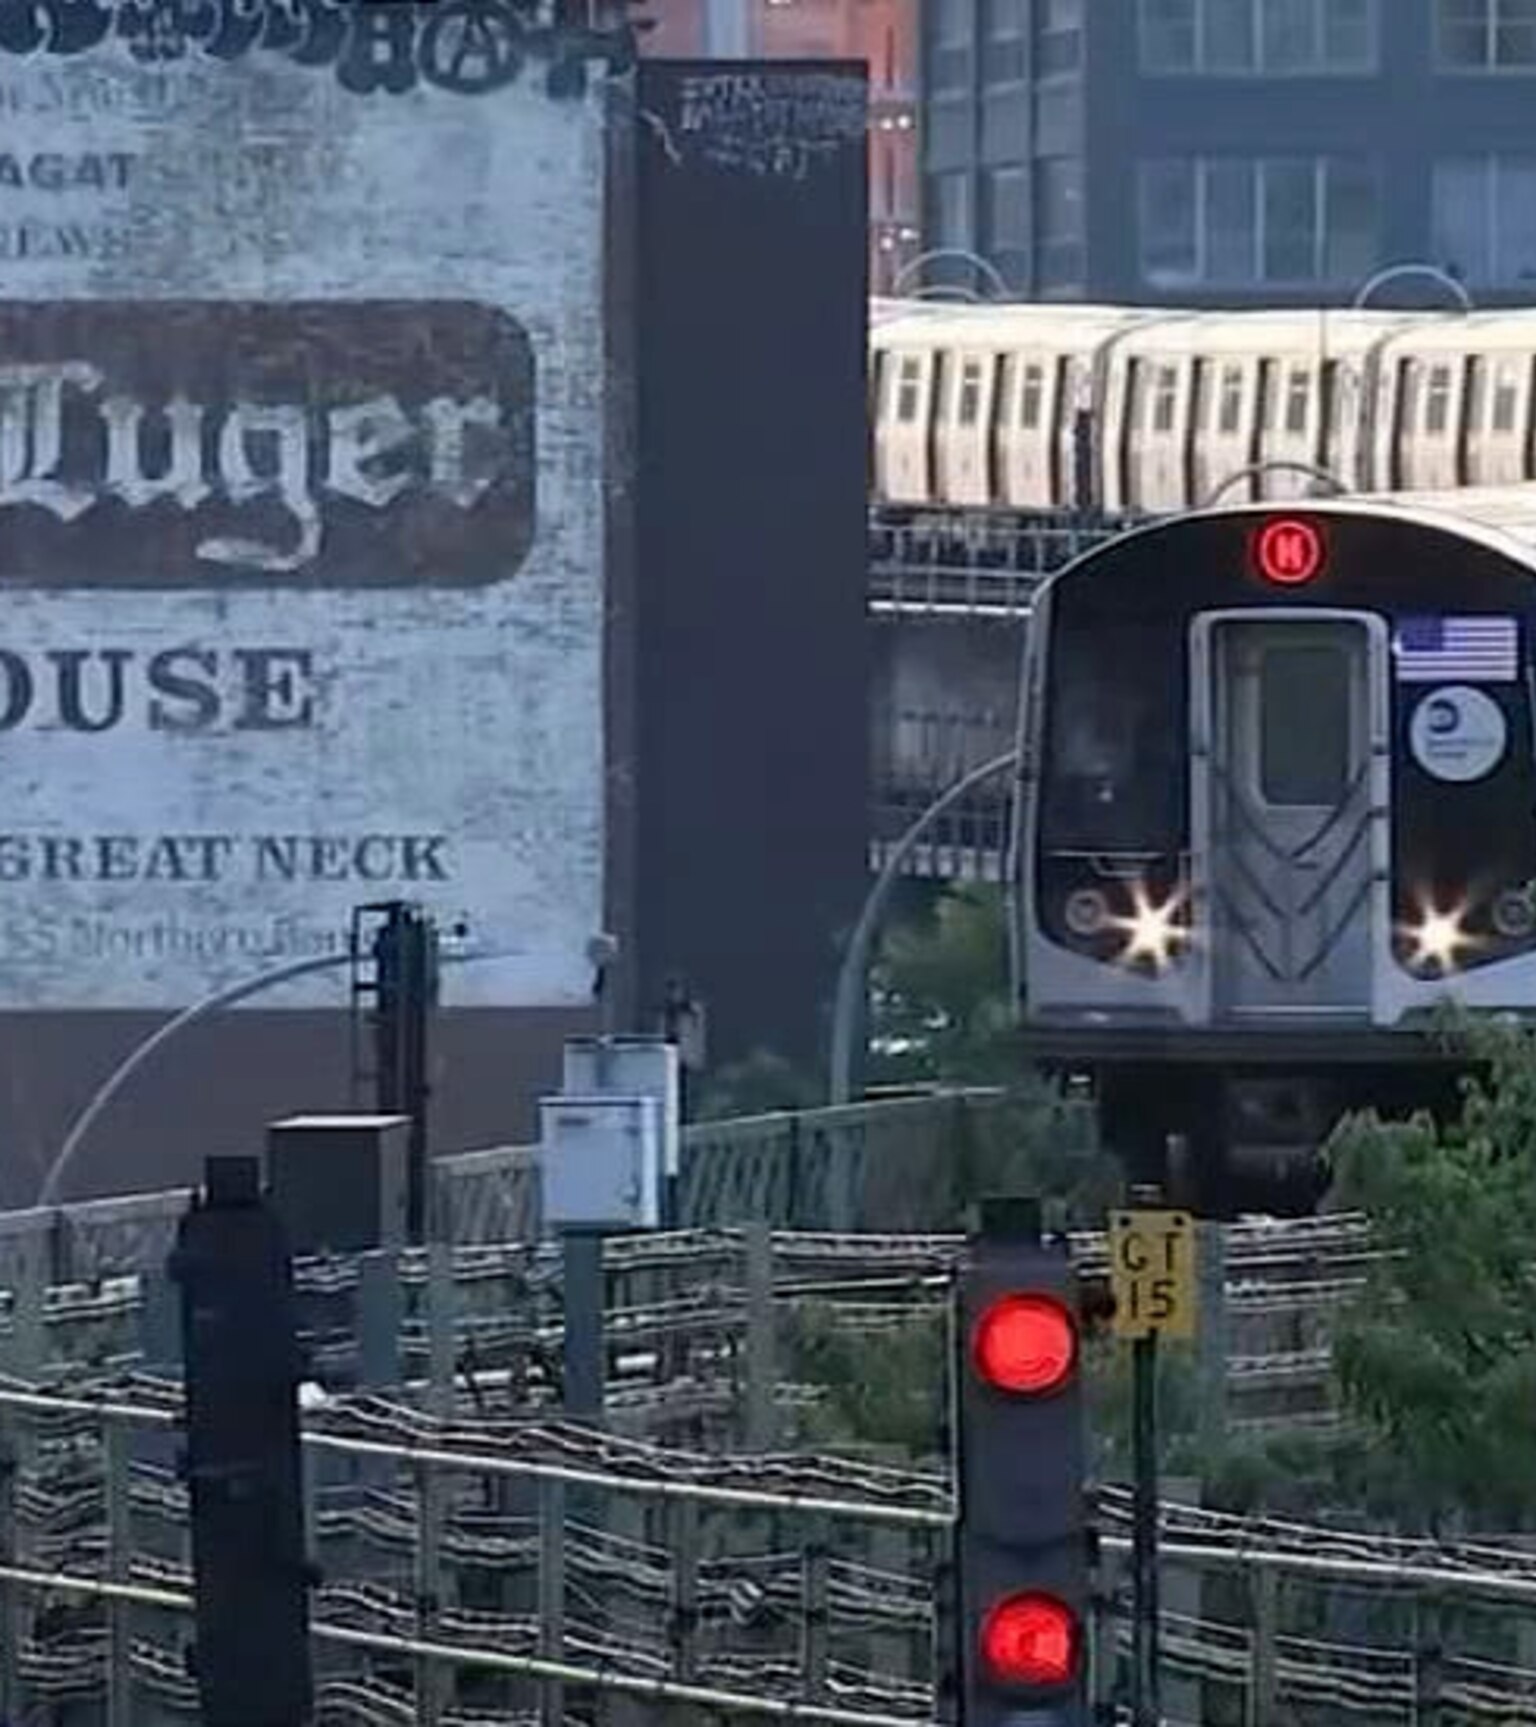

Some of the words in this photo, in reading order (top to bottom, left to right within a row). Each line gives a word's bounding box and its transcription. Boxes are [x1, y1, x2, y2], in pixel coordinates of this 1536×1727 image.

[0, 361, 500, 570] Luger
[0, 835, 231, 882] GREAT
[252, 834, 448, 882] NECK
[1121, 1231, 1182, 1271] GT
[1131, 1280, 1177, 1317] 15
